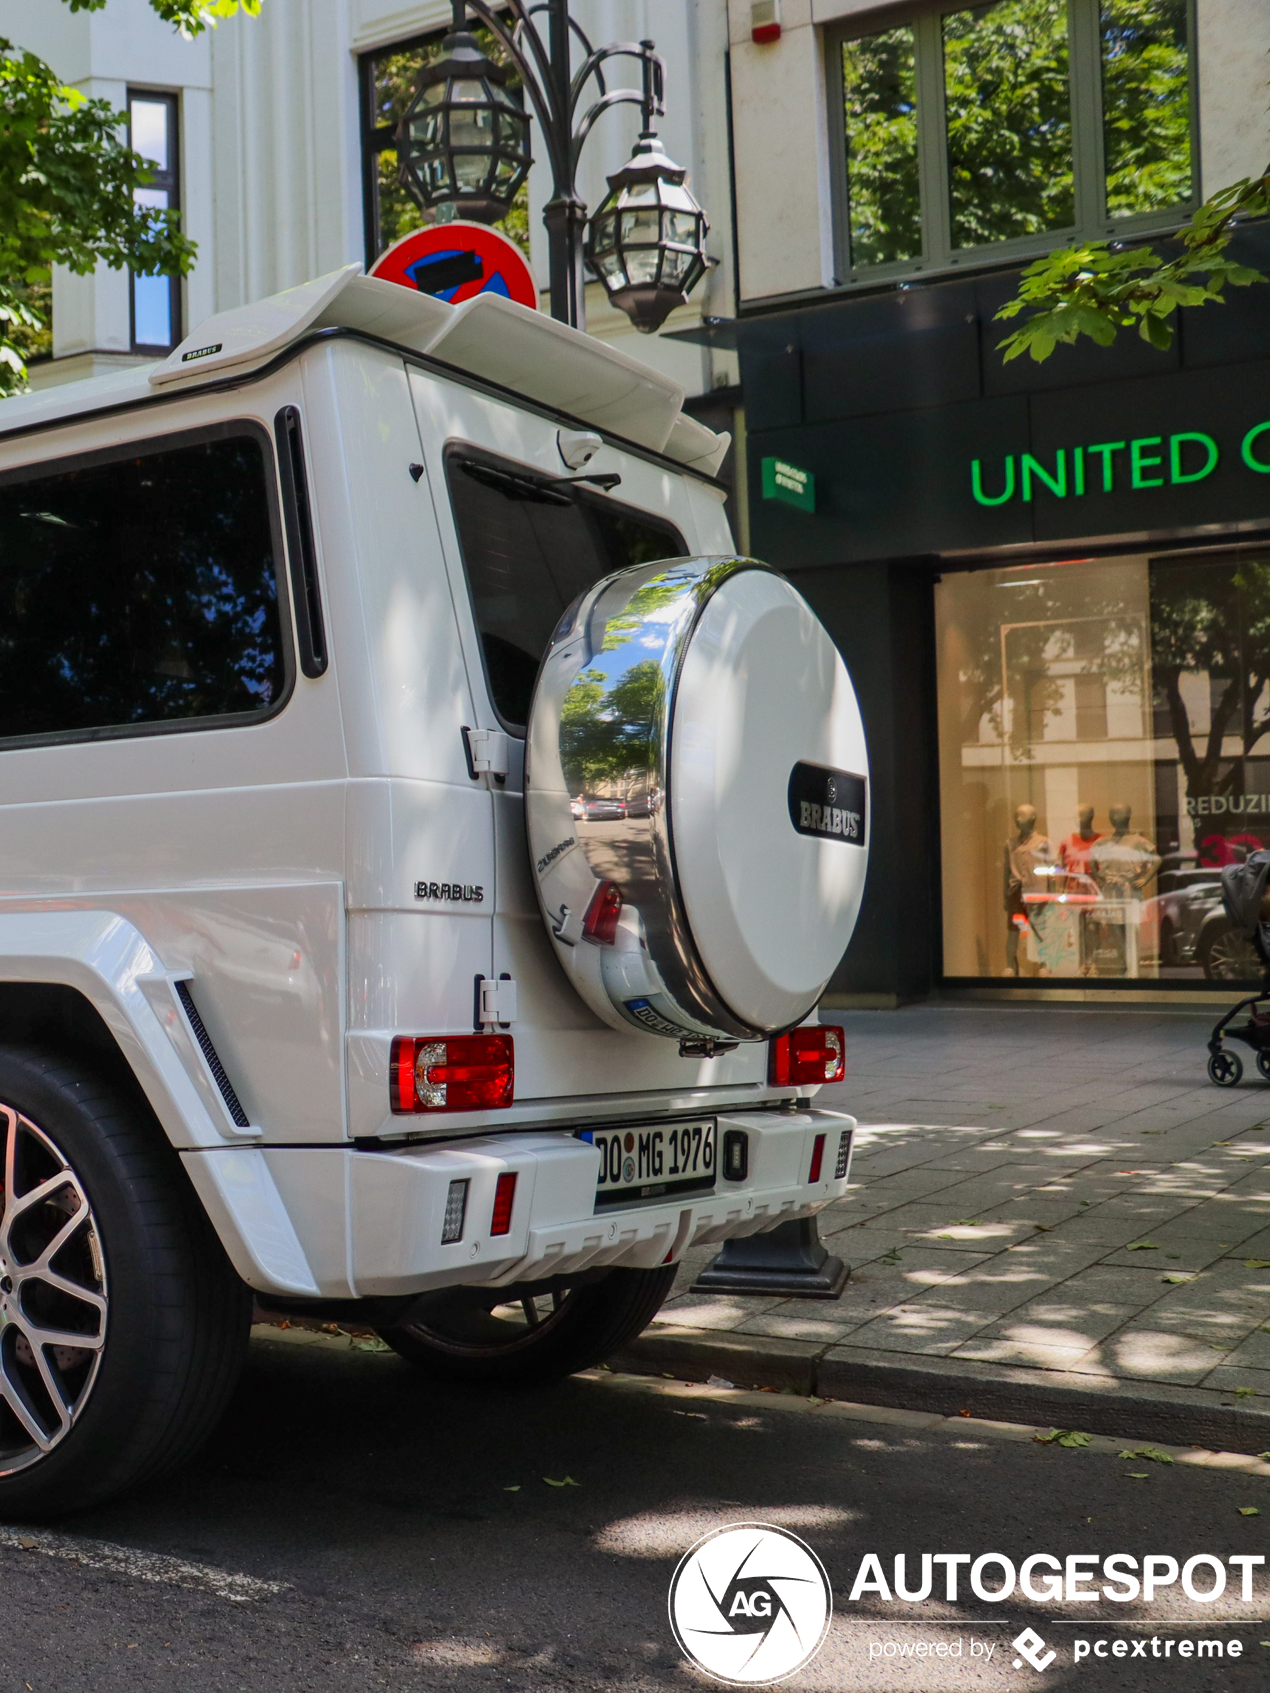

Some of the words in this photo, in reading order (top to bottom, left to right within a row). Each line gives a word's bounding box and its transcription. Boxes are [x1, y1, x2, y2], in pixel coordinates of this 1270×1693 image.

[186, 346, 218, 360] BRABUS
[971, 432, 1219, 507] UNITED
[800, 800, 860, 838] BRABUS
[414, 881, 484, 903] BRABUS
[595, 1134, 622, 1185] DO
[638, 1131, 664, 1179] MG
[669, 1126, 713, 1175] 1976
